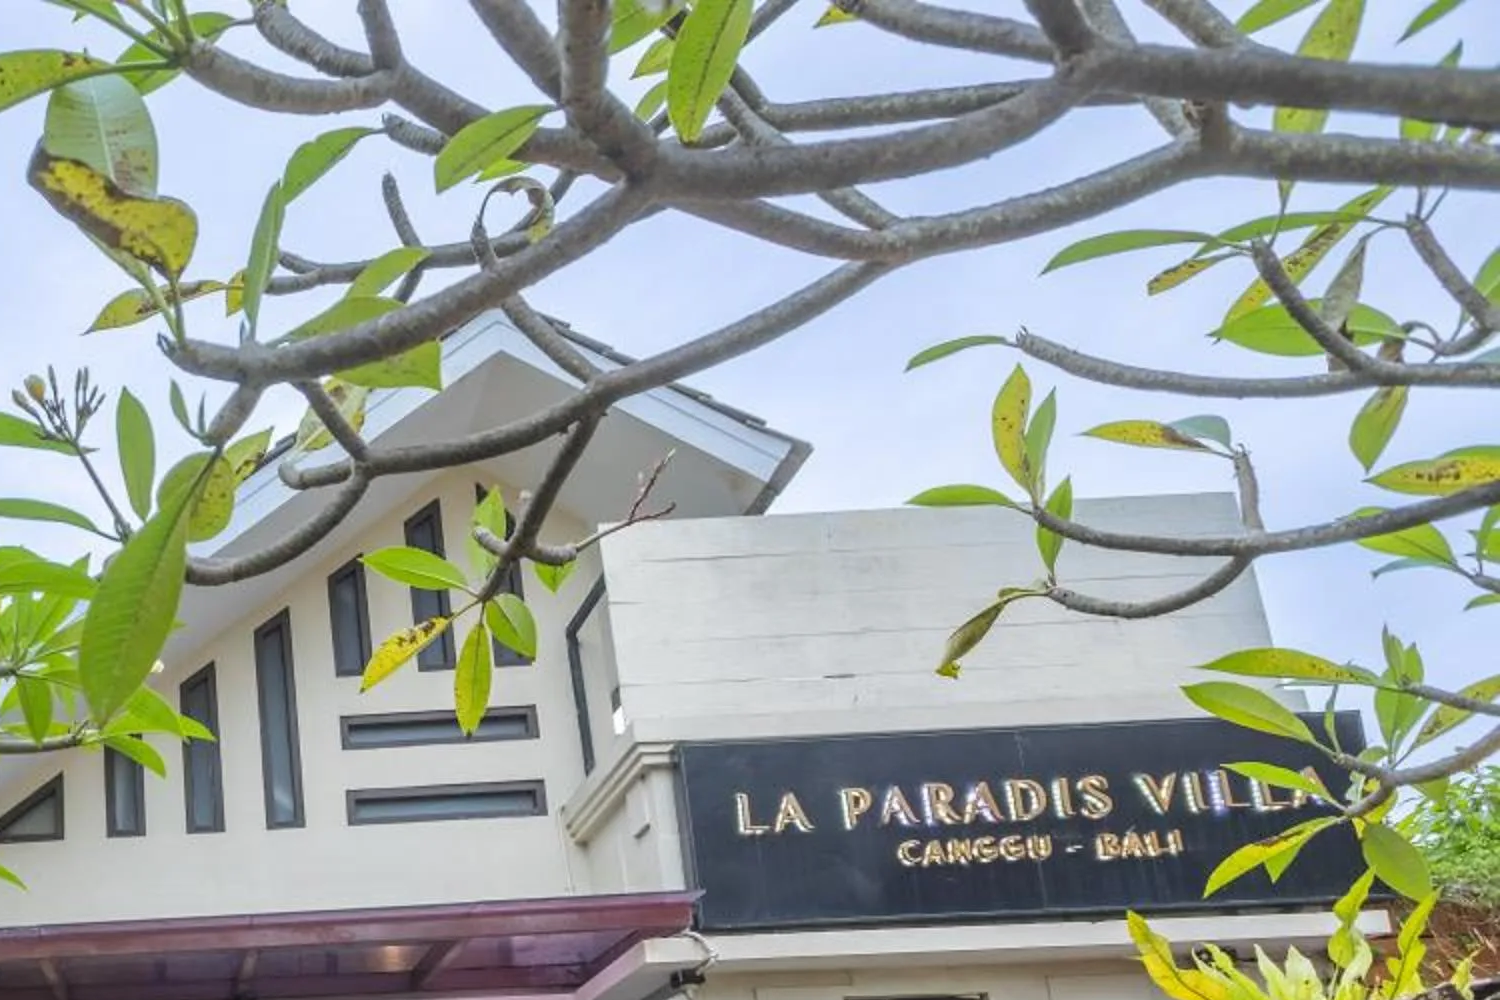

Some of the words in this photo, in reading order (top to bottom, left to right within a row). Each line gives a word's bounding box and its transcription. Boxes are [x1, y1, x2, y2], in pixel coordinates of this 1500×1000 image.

[735, 791, 815, 835] LA
[838, 774, 1114, 829] PARADIS
[1134, 766, 1328, 815] VILLA
[898, 833, 1053, 867] CANGGU
[1095, 829, 1184, 860] BALI
